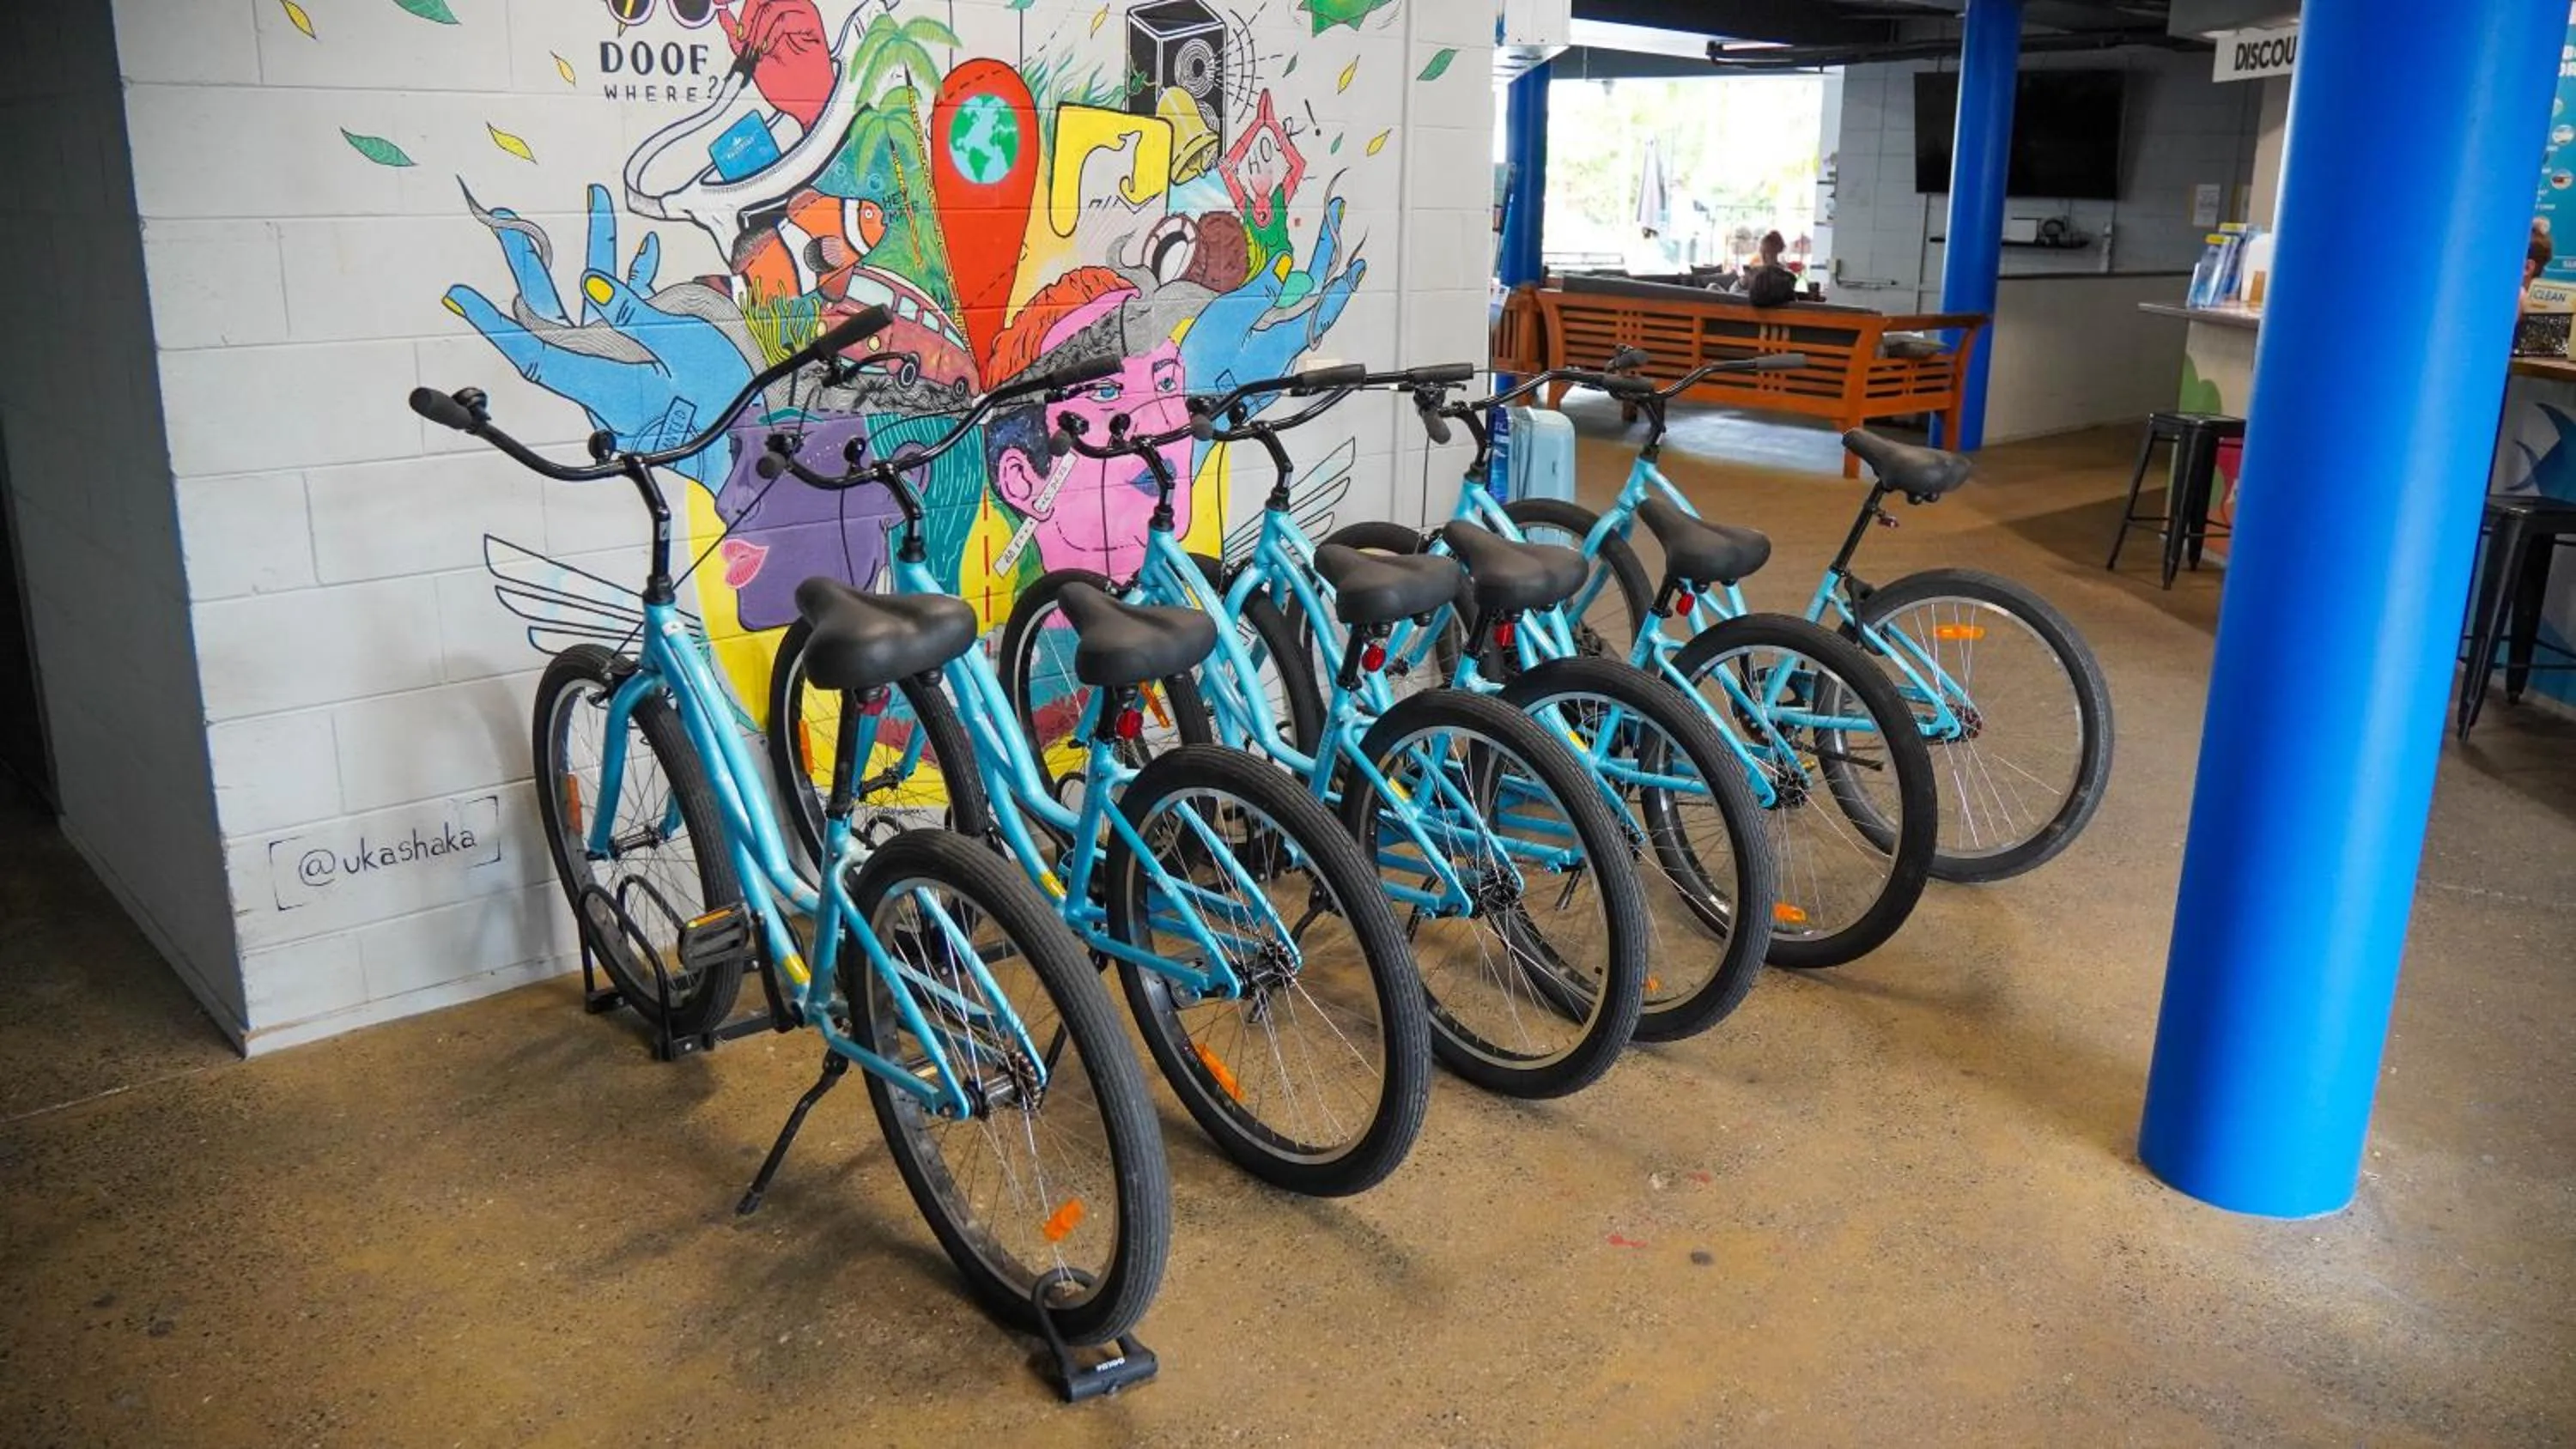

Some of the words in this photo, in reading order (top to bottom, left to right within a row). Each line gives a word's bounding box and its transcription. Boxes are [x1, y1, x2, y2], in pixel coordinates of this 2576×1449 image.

[600, 41, 708, 76] DOOF
[2234, 36, 2297, 70] DISCOU
[604, 75, 719, 102] WHERE?
[299, 822, 476, 887] @ukashaka
